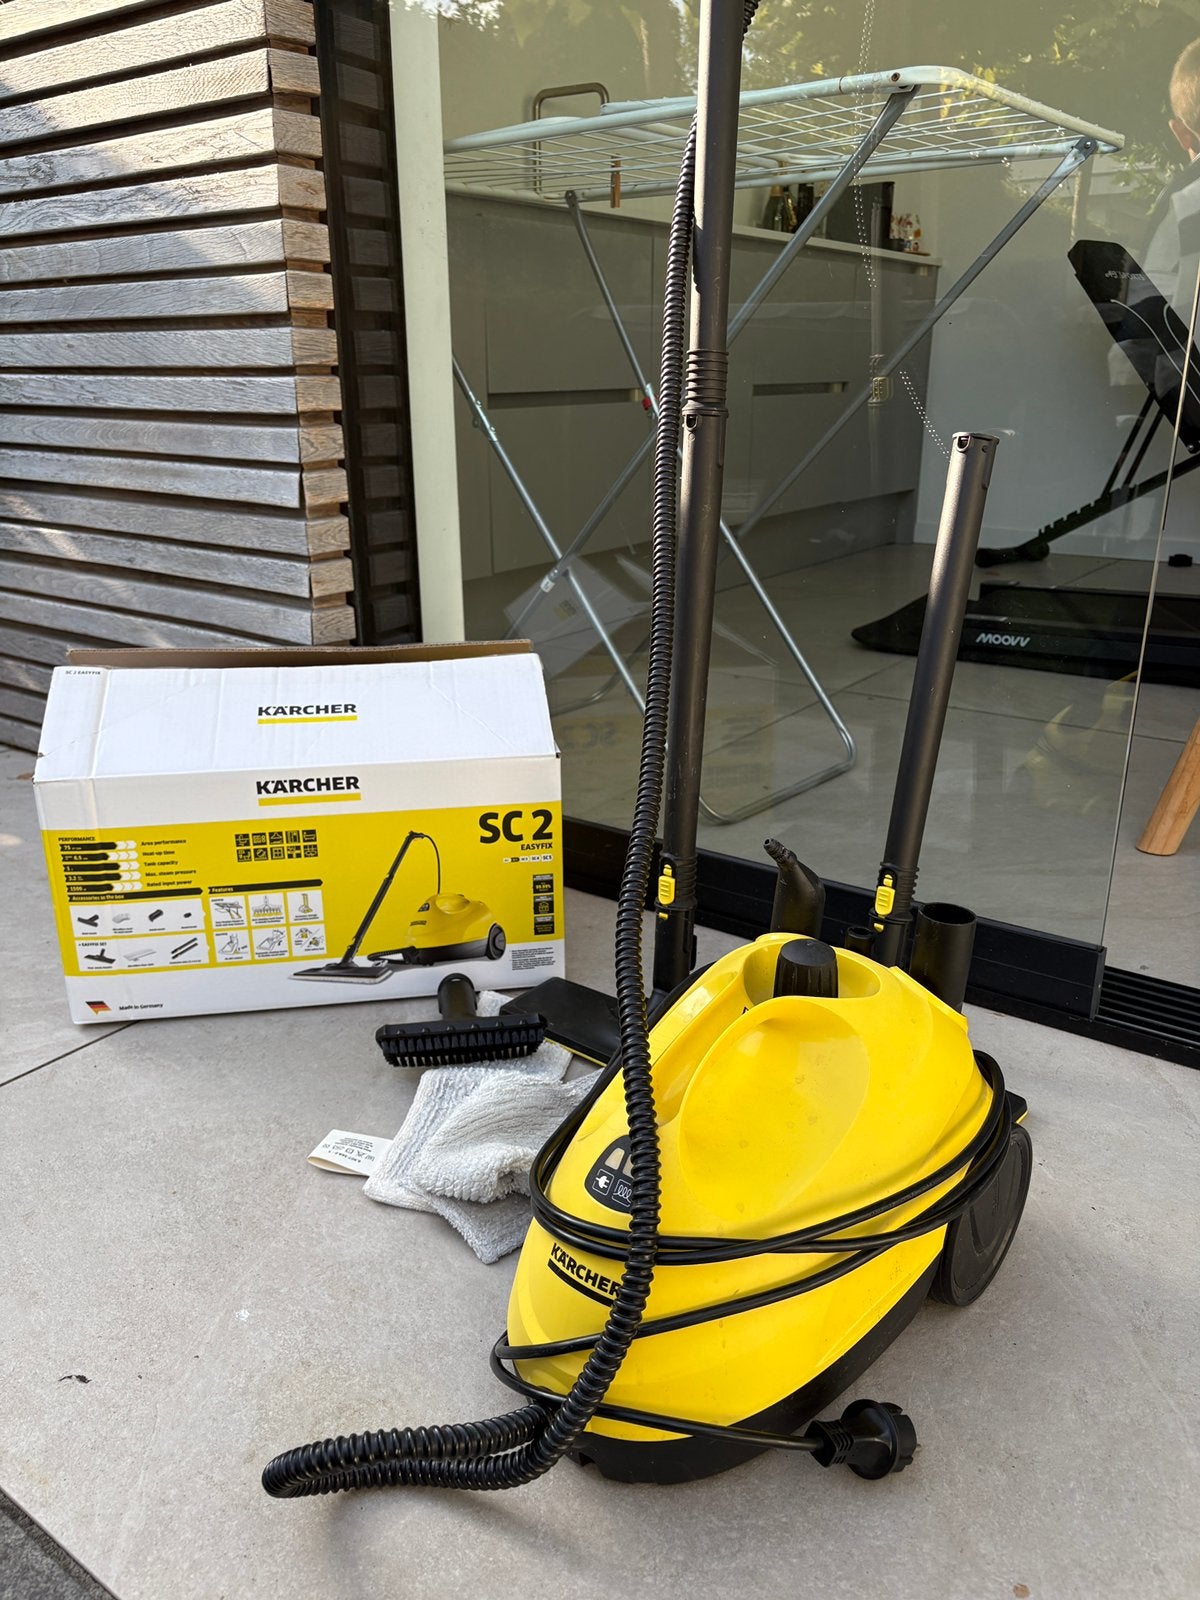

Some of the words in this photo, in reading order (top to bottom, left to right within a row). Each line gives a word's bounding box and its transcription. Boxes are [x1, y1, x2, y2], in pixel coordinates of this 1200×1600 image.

[975, 633, 1031, 648] MOOVV
[258, 703, 357, 717] KÄRCHER
[256, 776, 360, 794] KÄRCHER
[479, 811, 524, 844] SC
[532, 809, 553, 840] 2
[521, 843, 553, 851] EASYFIX
[550, 1242, 621, 1298] KÄRCHER
